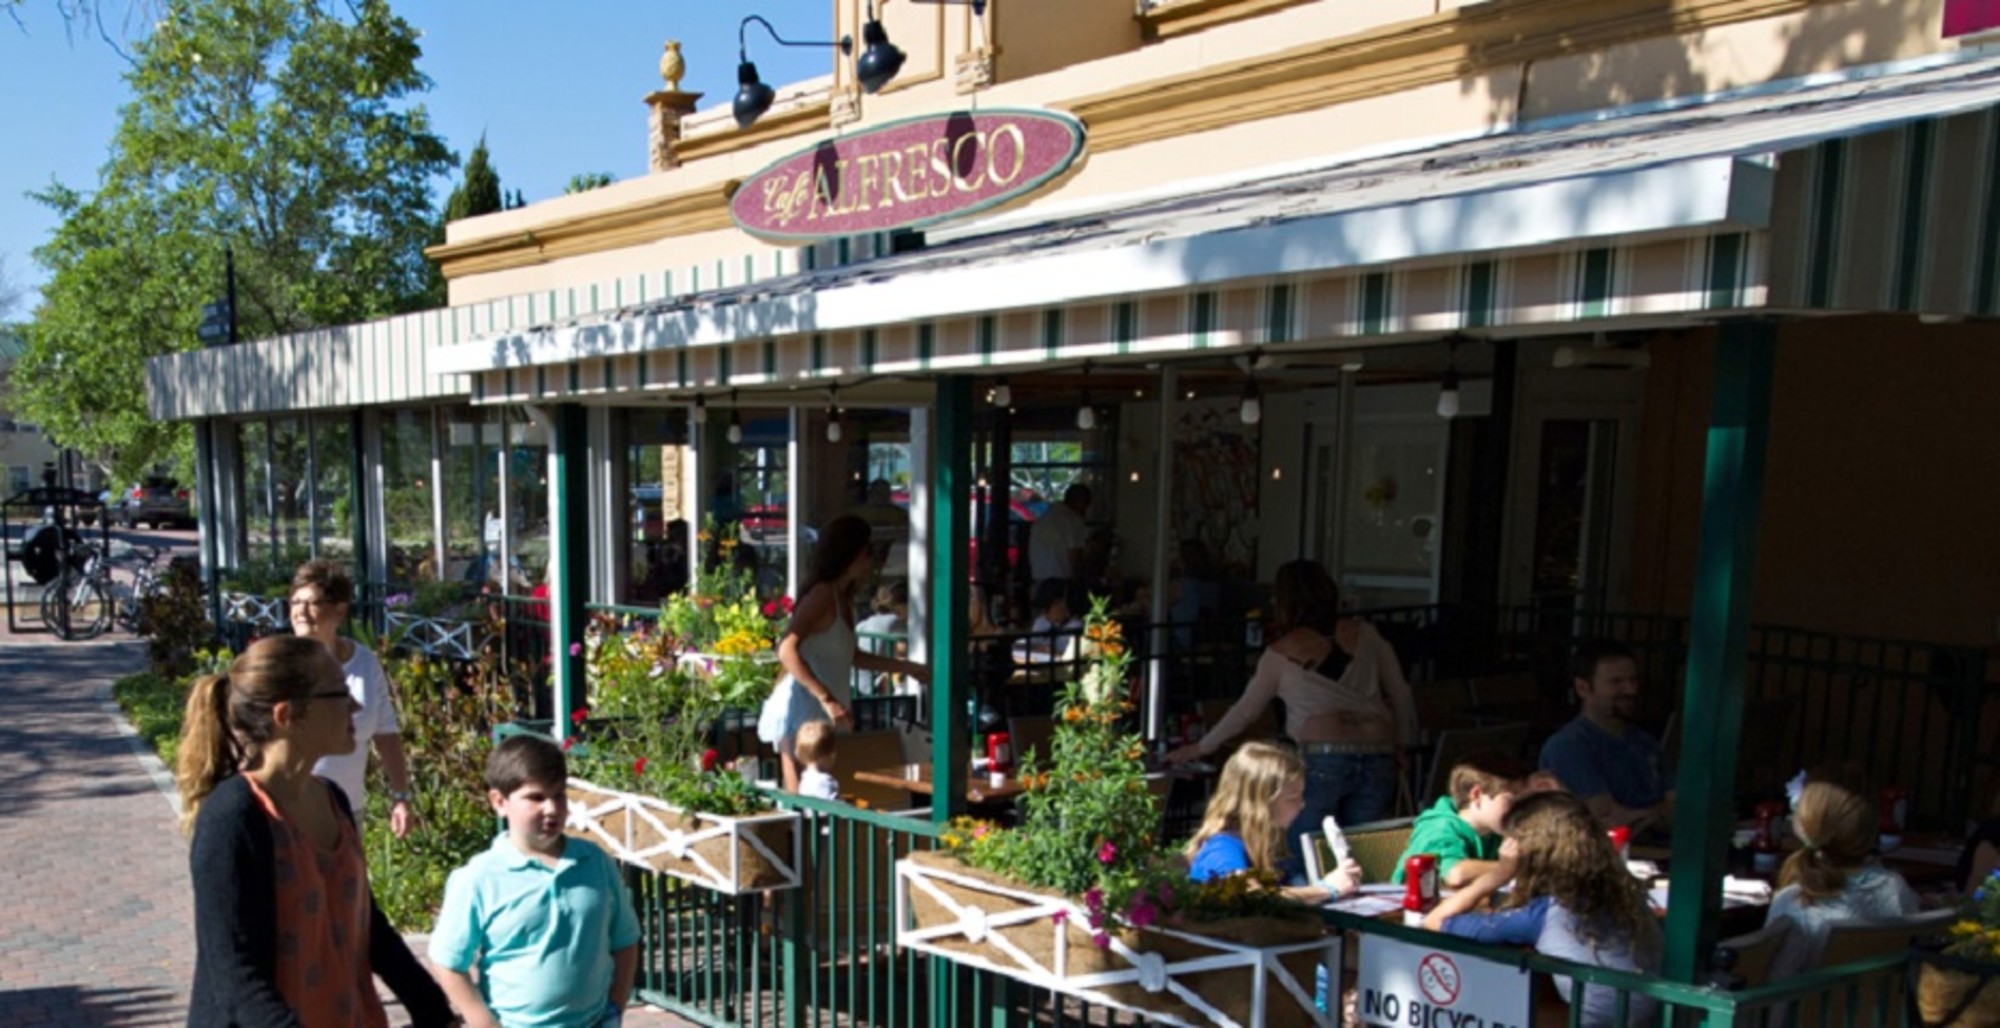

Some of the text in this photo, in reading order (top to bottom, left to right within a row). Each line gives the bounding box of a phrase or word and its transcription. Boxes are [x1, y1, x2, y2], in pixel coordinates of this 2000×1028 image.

[806, 123, 1026, 219] ALFRESCO
[1364, 989, 1519, 1028] NO BICYC
